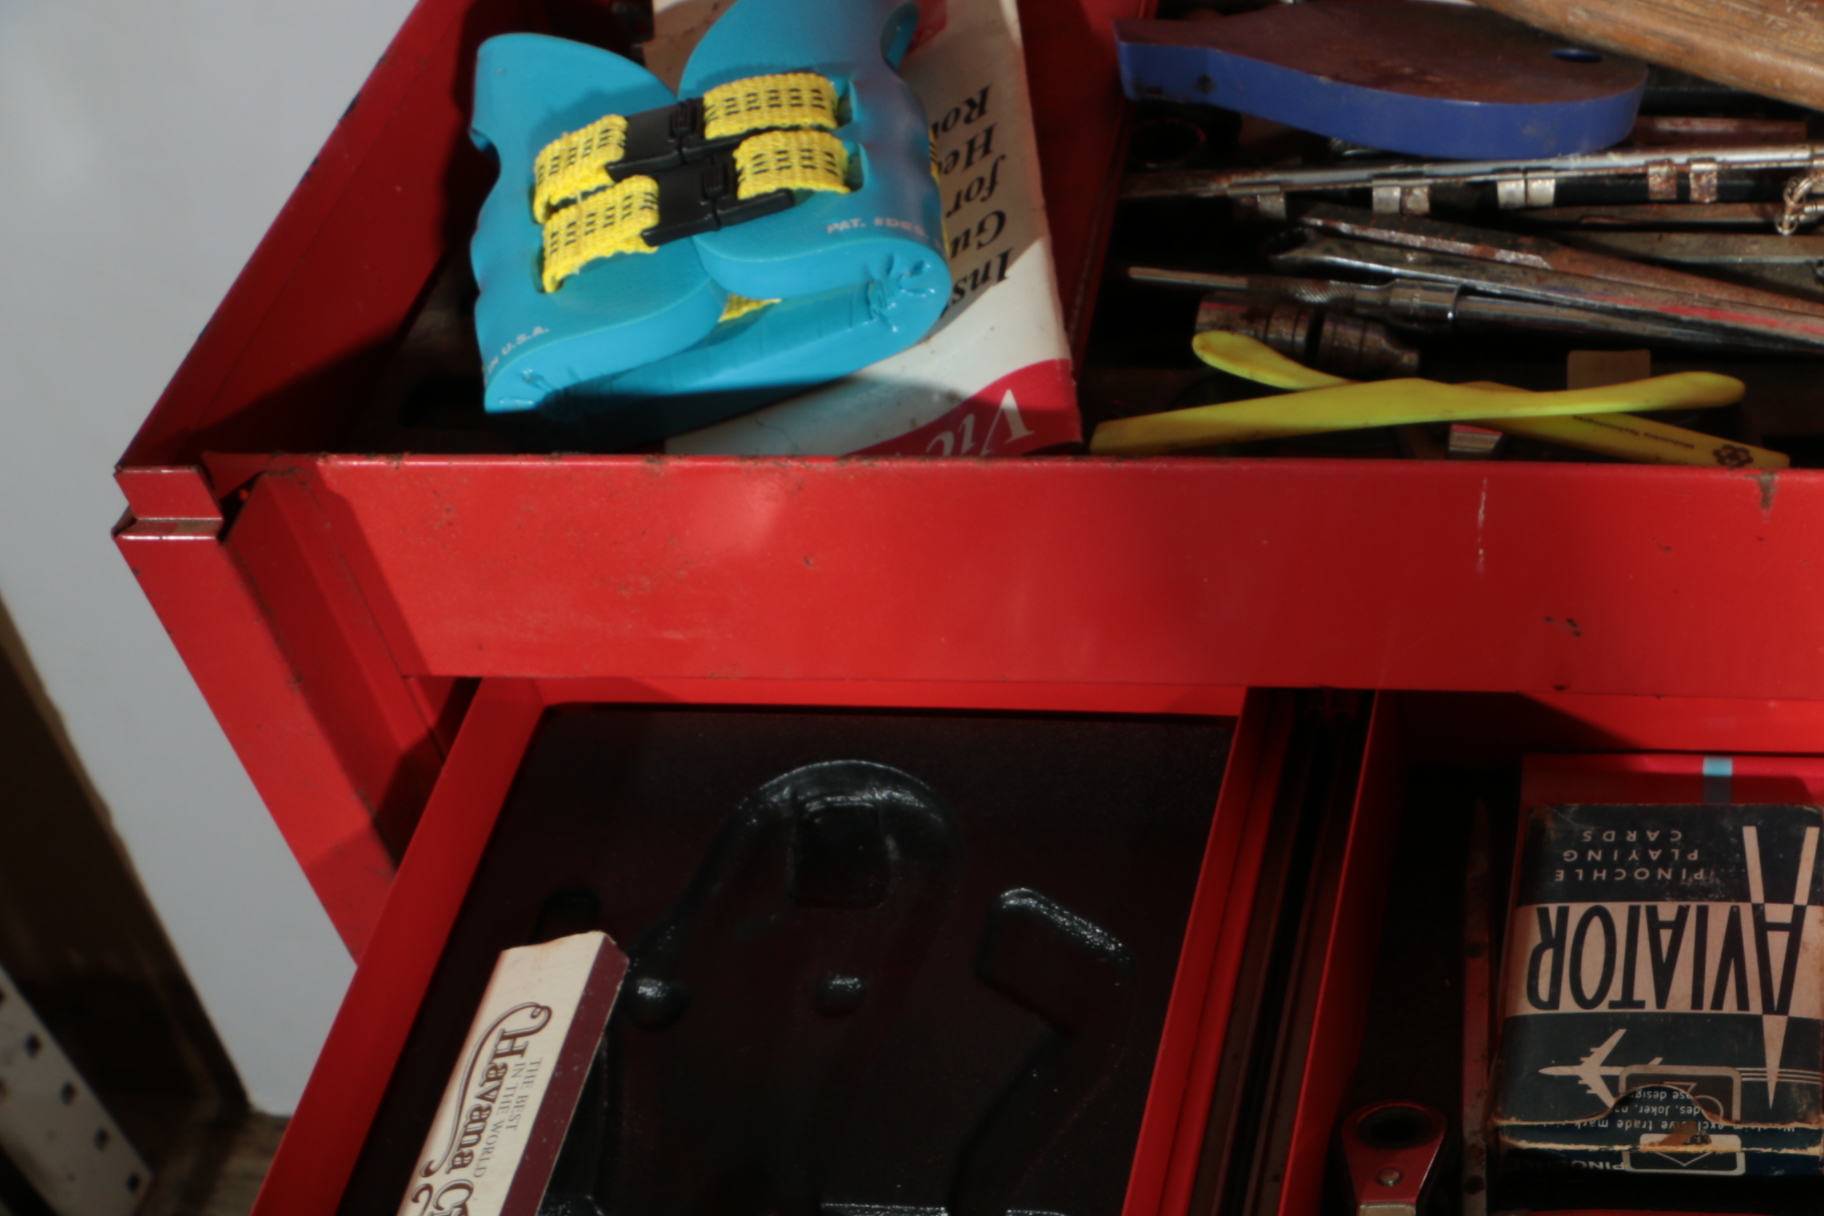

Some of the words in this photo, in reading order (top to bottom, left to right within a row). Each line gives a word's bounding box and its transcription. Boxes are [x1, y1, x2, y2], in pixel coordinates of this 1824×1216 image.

[944, 153, 1007, 219] for
[1582, 829, 1683, 843] CARDS
[1562, 848, 1700, 863] PLAYING
[1554, 867, 1706, 882] PINOCHLE
[1525, 903, 1810, 1015] AVIATOR
[510, 1061, 526, 1080] IN
[526, 1056, 544, 1090] THE
[432, 1015, 540, 1176] Havana
[497, 1081, 519, 1116] THE
[1631, 1089, 1667, 1102] desig
[504, 1090, 529, 1132] BEST
[1635, 1104, 1671, 1117] Joker,
[1574, 1119, 1609, 1130] mark
[1616, 1119, 1653, 1131] trade
[473, 1116, 507, 1180] WORLD
